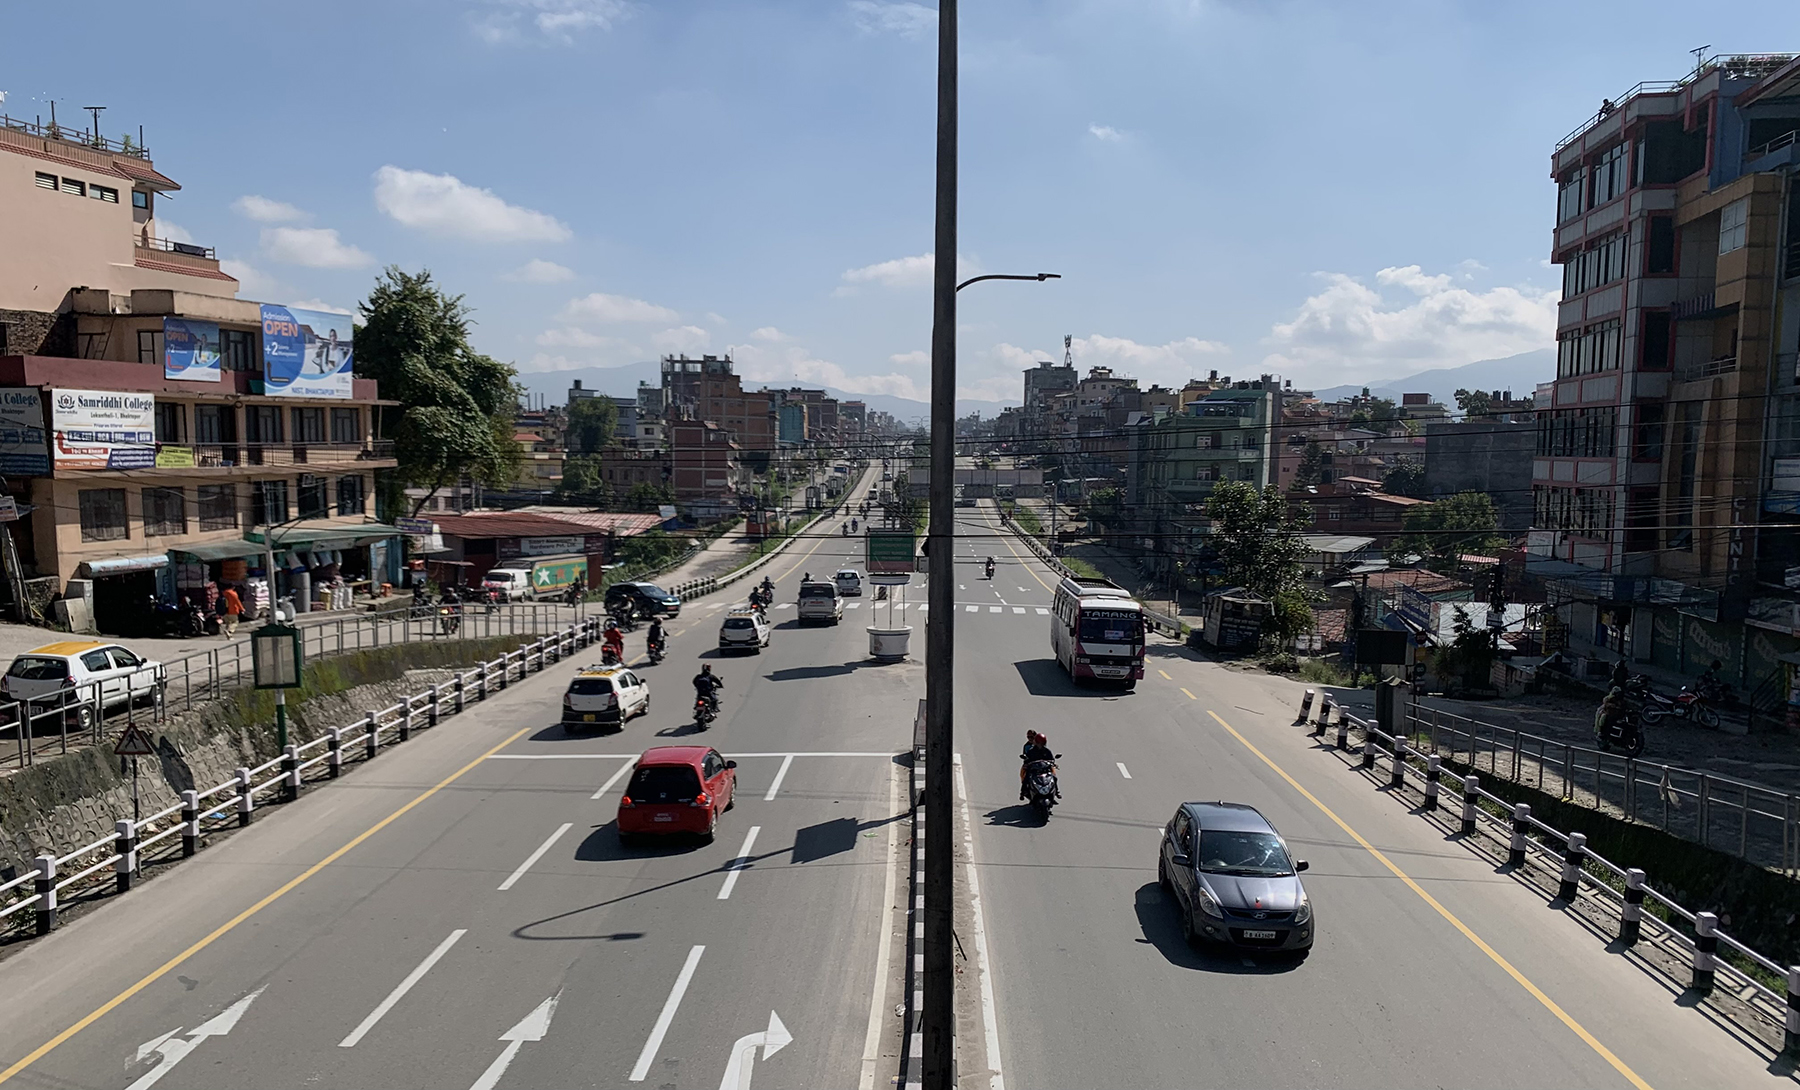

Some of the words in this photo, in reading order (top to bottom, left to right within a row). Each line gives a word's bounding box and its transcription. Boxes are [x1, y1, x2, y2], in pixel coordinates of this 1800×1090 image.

[263, 311, 291, 321] Admission
[264, 320, 298, 337] OPEN
[166, 331, 188, 342] OPEN
[4, 393, 38, 407] College
[78, 395, 122, 408] Samriddhi
[124, 397, 153, 412] College
[1728, 498, 1746, 586] CLINIC
[1084, 611, 1137, 619] TAMANG
